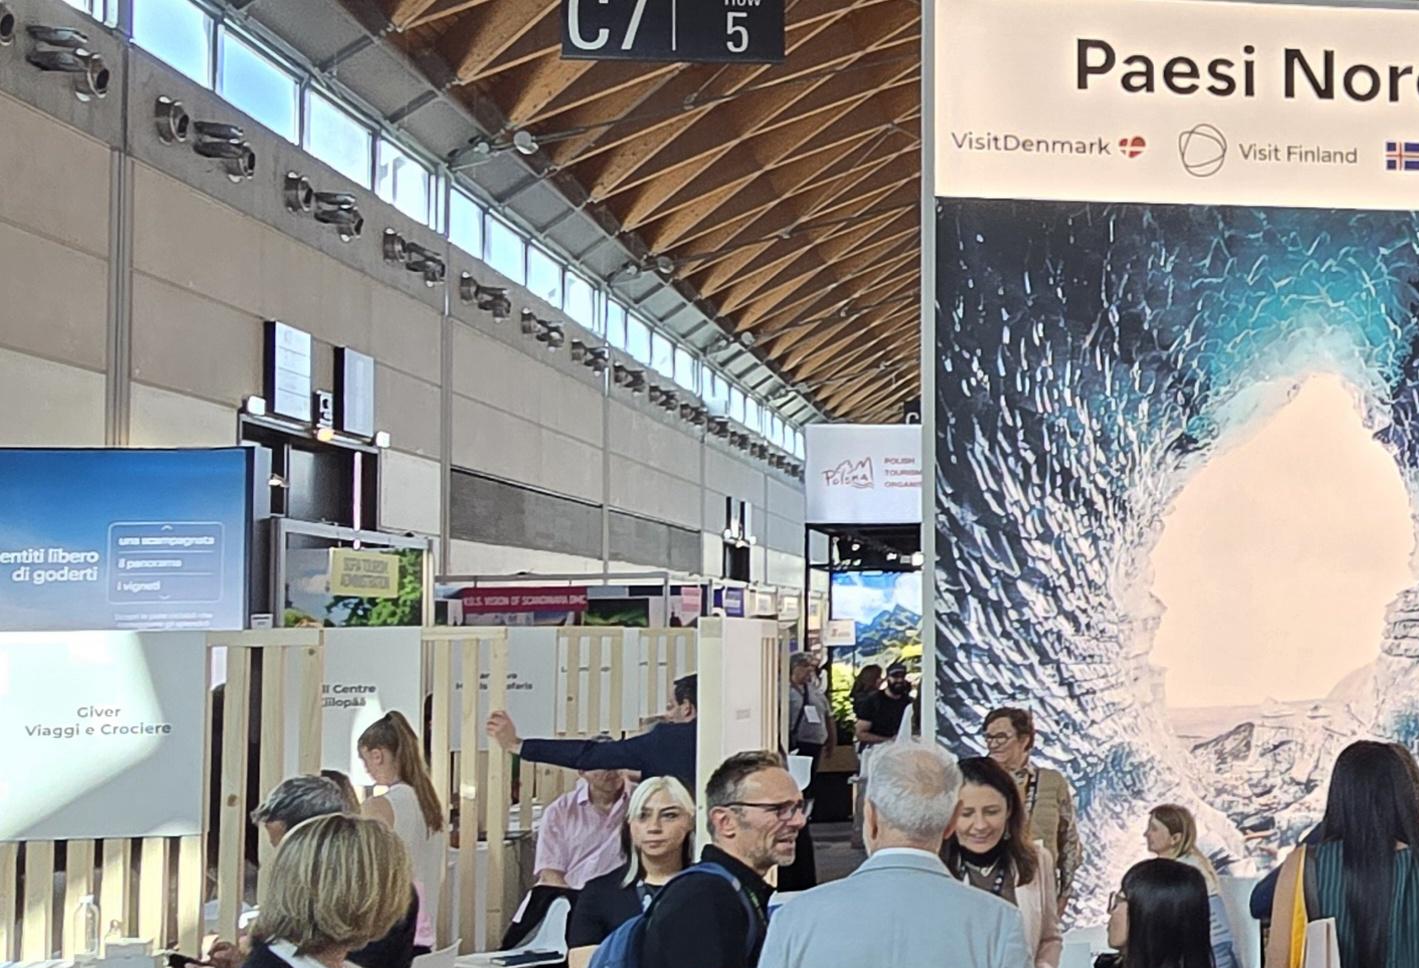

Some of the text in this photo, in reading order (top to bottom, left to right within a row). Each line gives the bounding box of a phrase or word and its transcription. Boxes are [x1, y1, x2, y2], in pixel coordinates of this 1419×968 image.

[567, 0, 648, 50] C7
[726, 12, 749, 52] 5
[1077, 38, 1255, 97] Paesi
[951, 132, 1111, 156] VisitDenmark
[1239, 143, 1358, 165] Visit Finland
[0, 548, 99, 564] entiti libero
[12, 567, 98, 585] di goderti
[332, 683, 376, 695] Centre
[77, 705, 121, 719] Giver
[25, 722, 172, 739] Viaggi e Crociere
